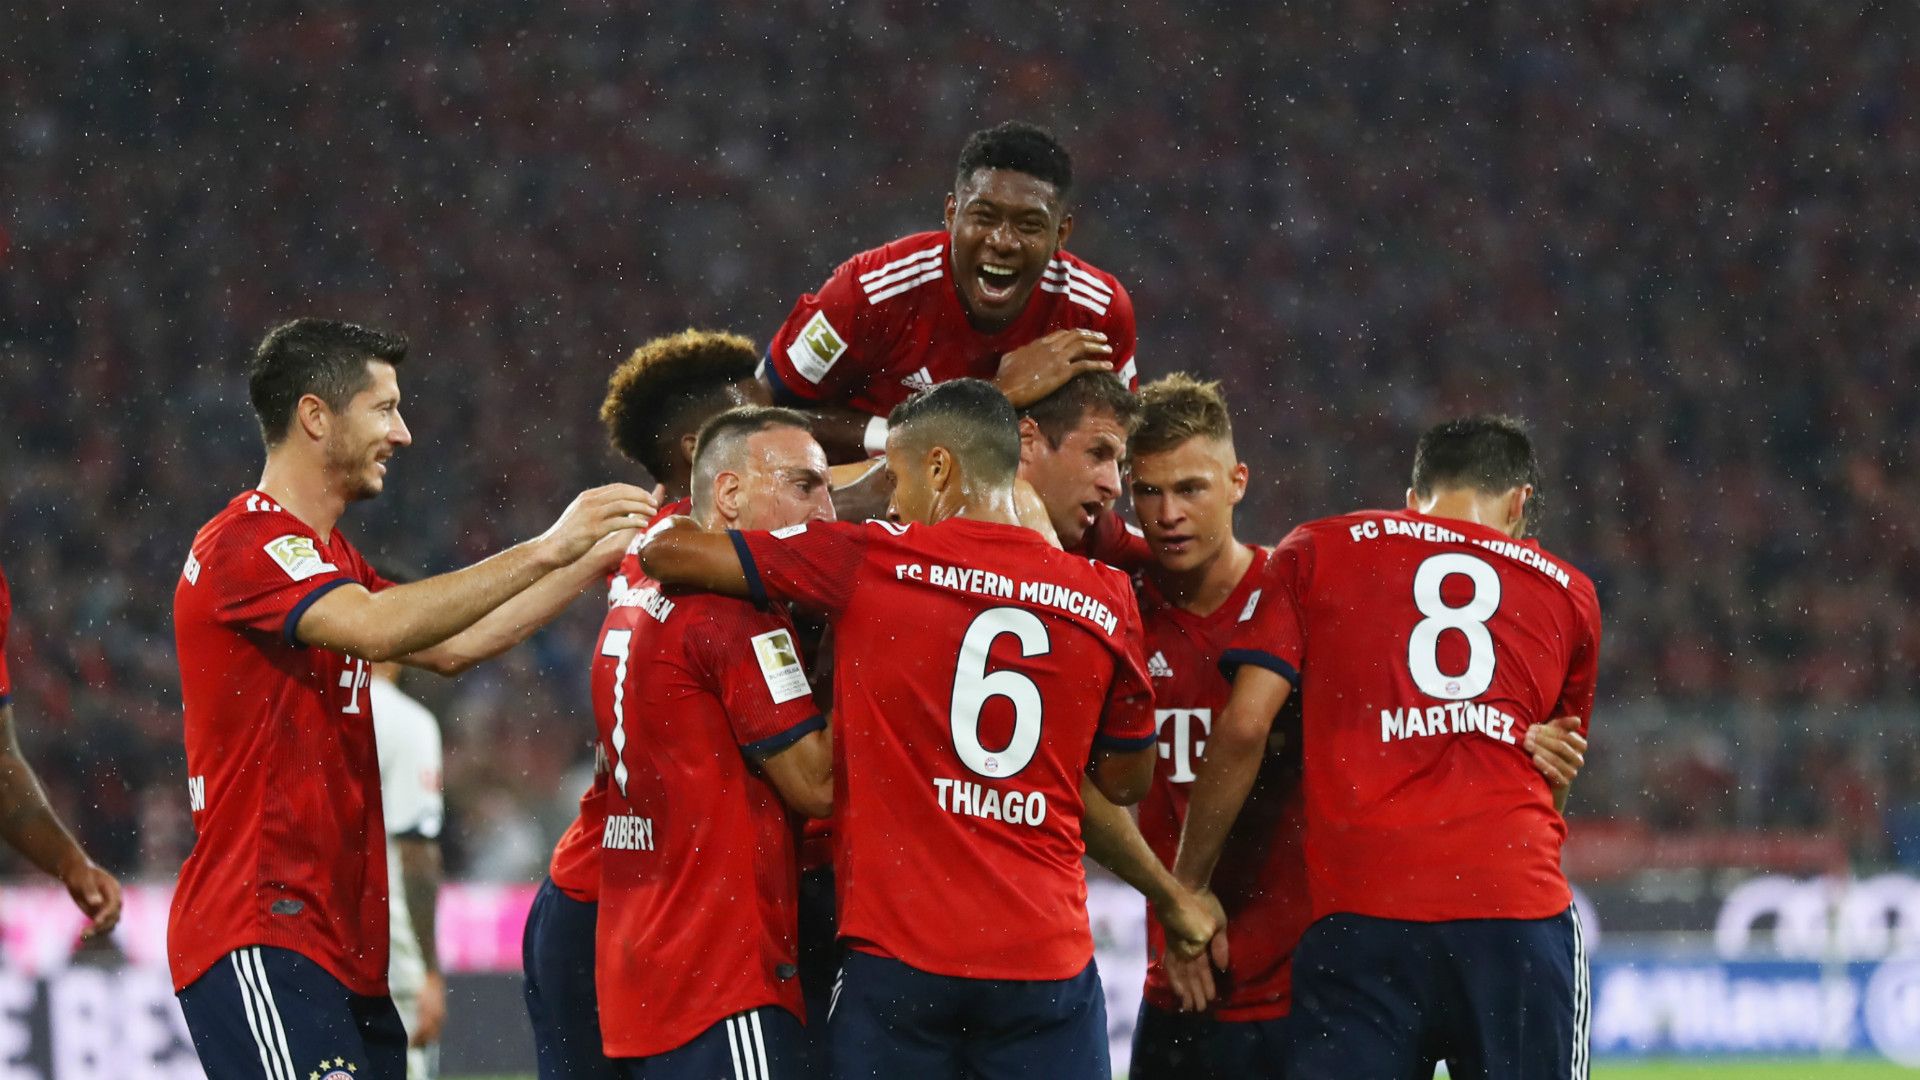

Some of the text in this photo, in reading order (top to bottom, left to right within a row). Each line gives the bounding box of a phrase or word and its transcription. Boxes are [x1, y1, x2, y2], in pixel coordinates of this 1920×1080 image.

[1350, 520, 1379, 542] FC
[1383, 518, 1466, 543] BAYERN
[895, 564, 1118, 636] FC BAYERN MÜNCHEN
[1407, 552, 1502, 700] 8
[601, 629, 633, 798] 7
[950, 606, 1051, 778] 6
[1381, 700, 1516, 745] MARTÍNEZ
[1154, 708, 1212, 783] T
[602, 808, 654, 851] RIBÉRY
[933, 777, 1047, 827] THIAGO
